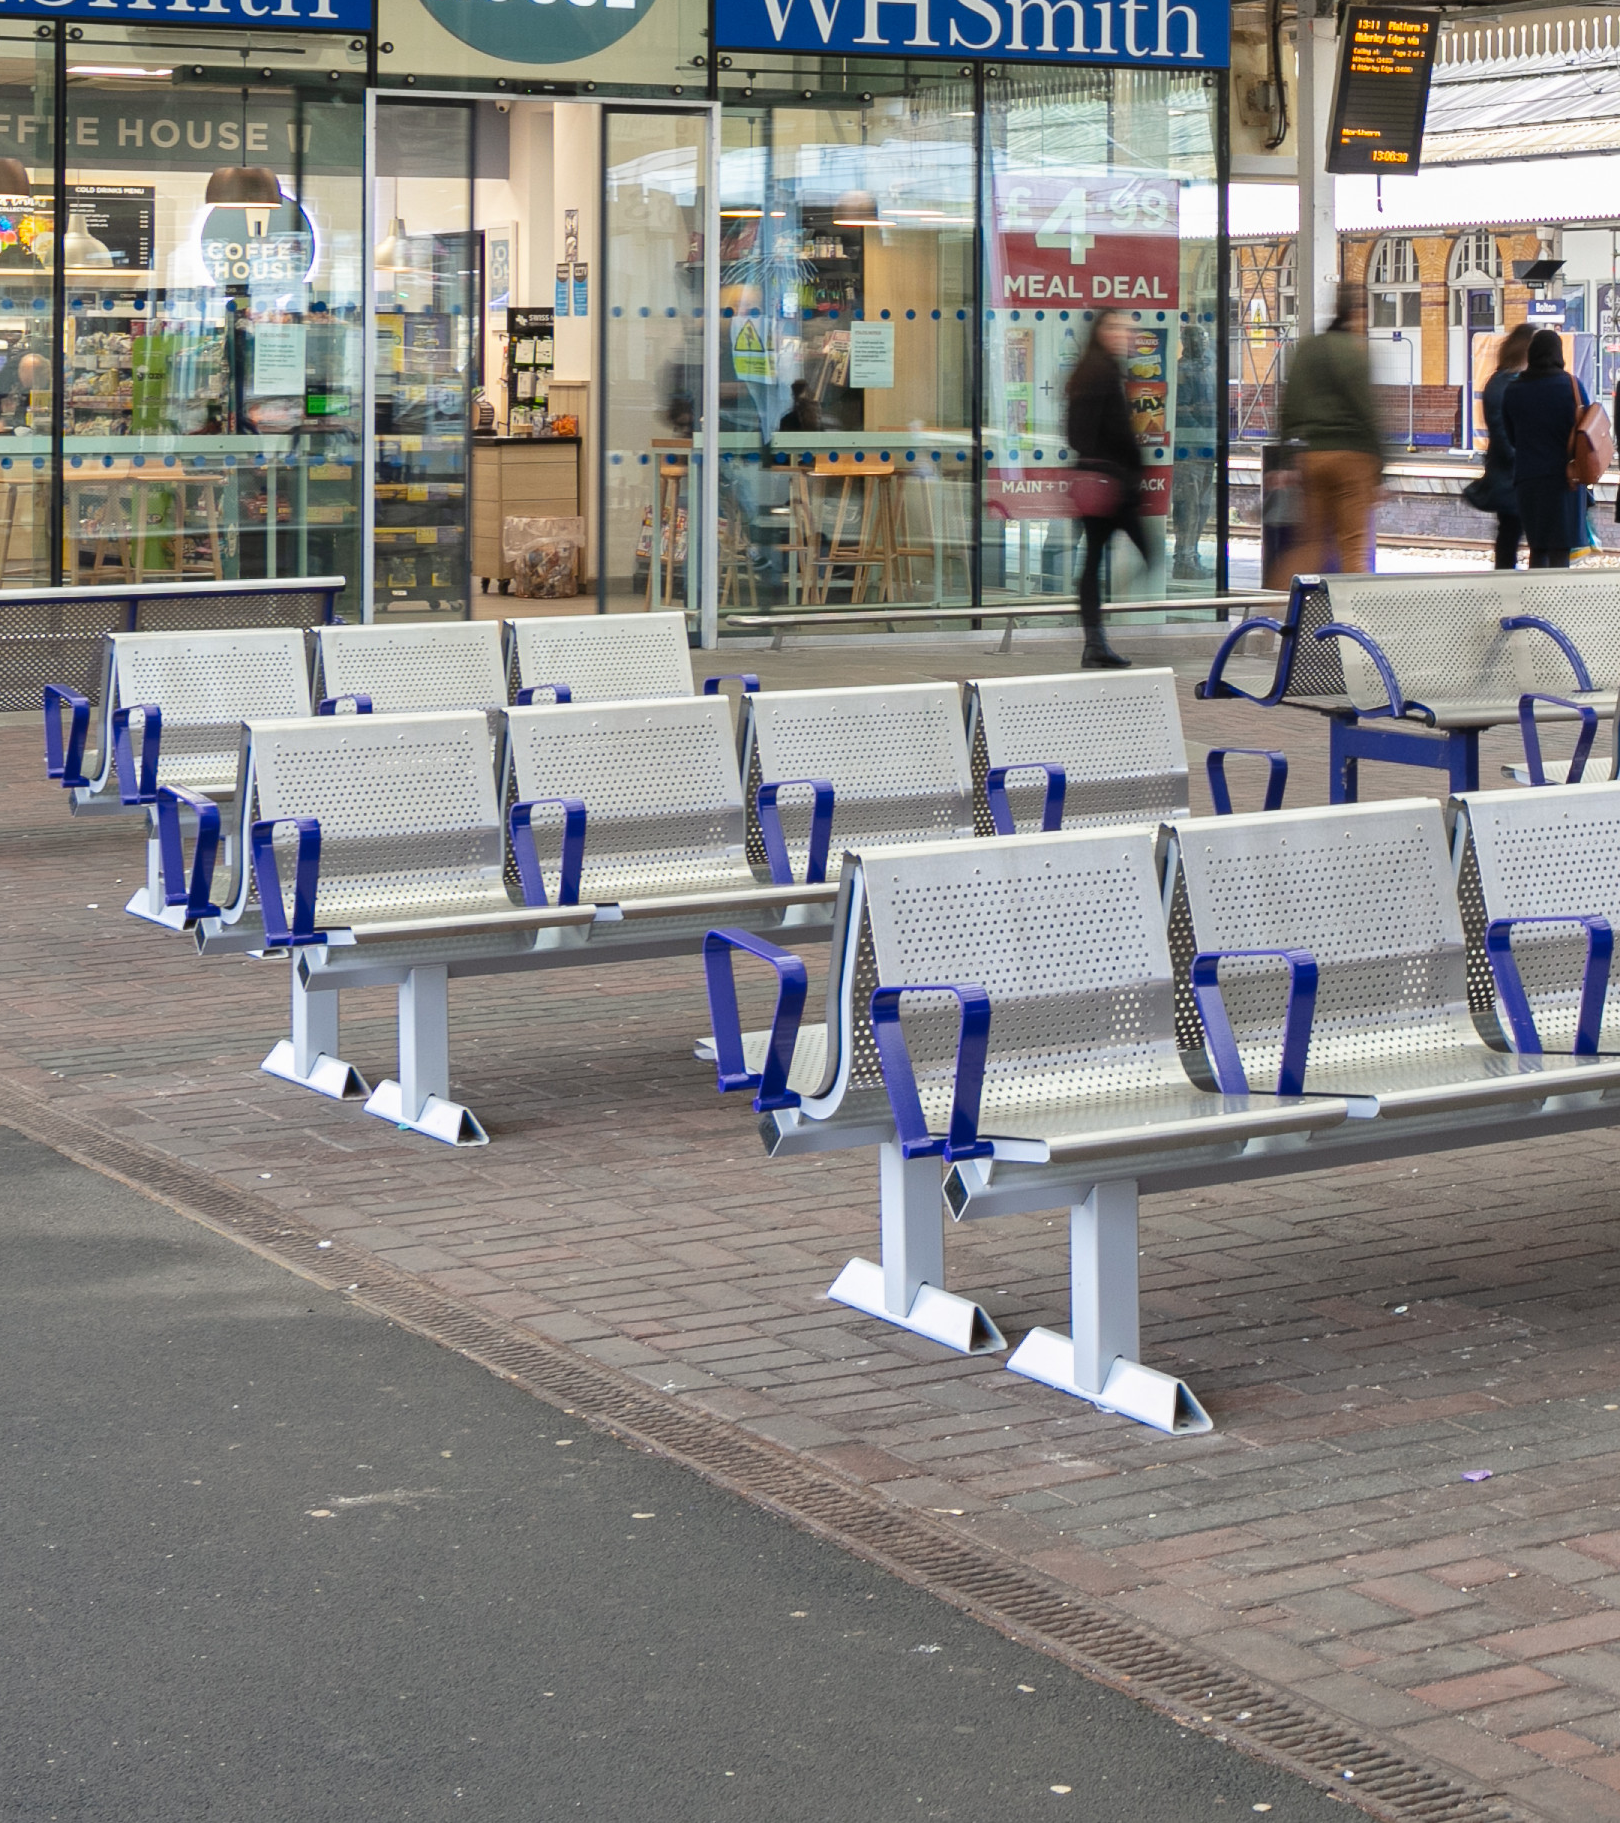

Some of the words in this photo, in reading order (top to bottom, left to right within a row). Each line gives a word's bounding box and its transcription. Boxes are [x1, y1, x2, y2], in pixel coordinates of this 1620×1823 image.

[1358, 19, 1380, 30] 13:11
[1388, 21, 1420, 32] Platform
[1422, 23, 1428, 32] 3
[1355, 32, 1386, 44] Alderley
[1387, 34, 1405, 45] Edge
[1407, 36, 1419, 45] via
[118, 118, 268, 151] HOUSE
[1342, 129, 1380, 137] Northern
[75, 186, 96, 194] COLD
[97, 186, 122, 194] DRINKS
[122, 187, 145, 195] MENU
[1004, 275, 1083, 298] MEAL
[1092, 276, 1168, 299] DEAL
[1536, 303, 1556, 313] Bolton
[1002, 481, 1042, 493] MAIN
[1139, 479, 1165, 491] ACK
